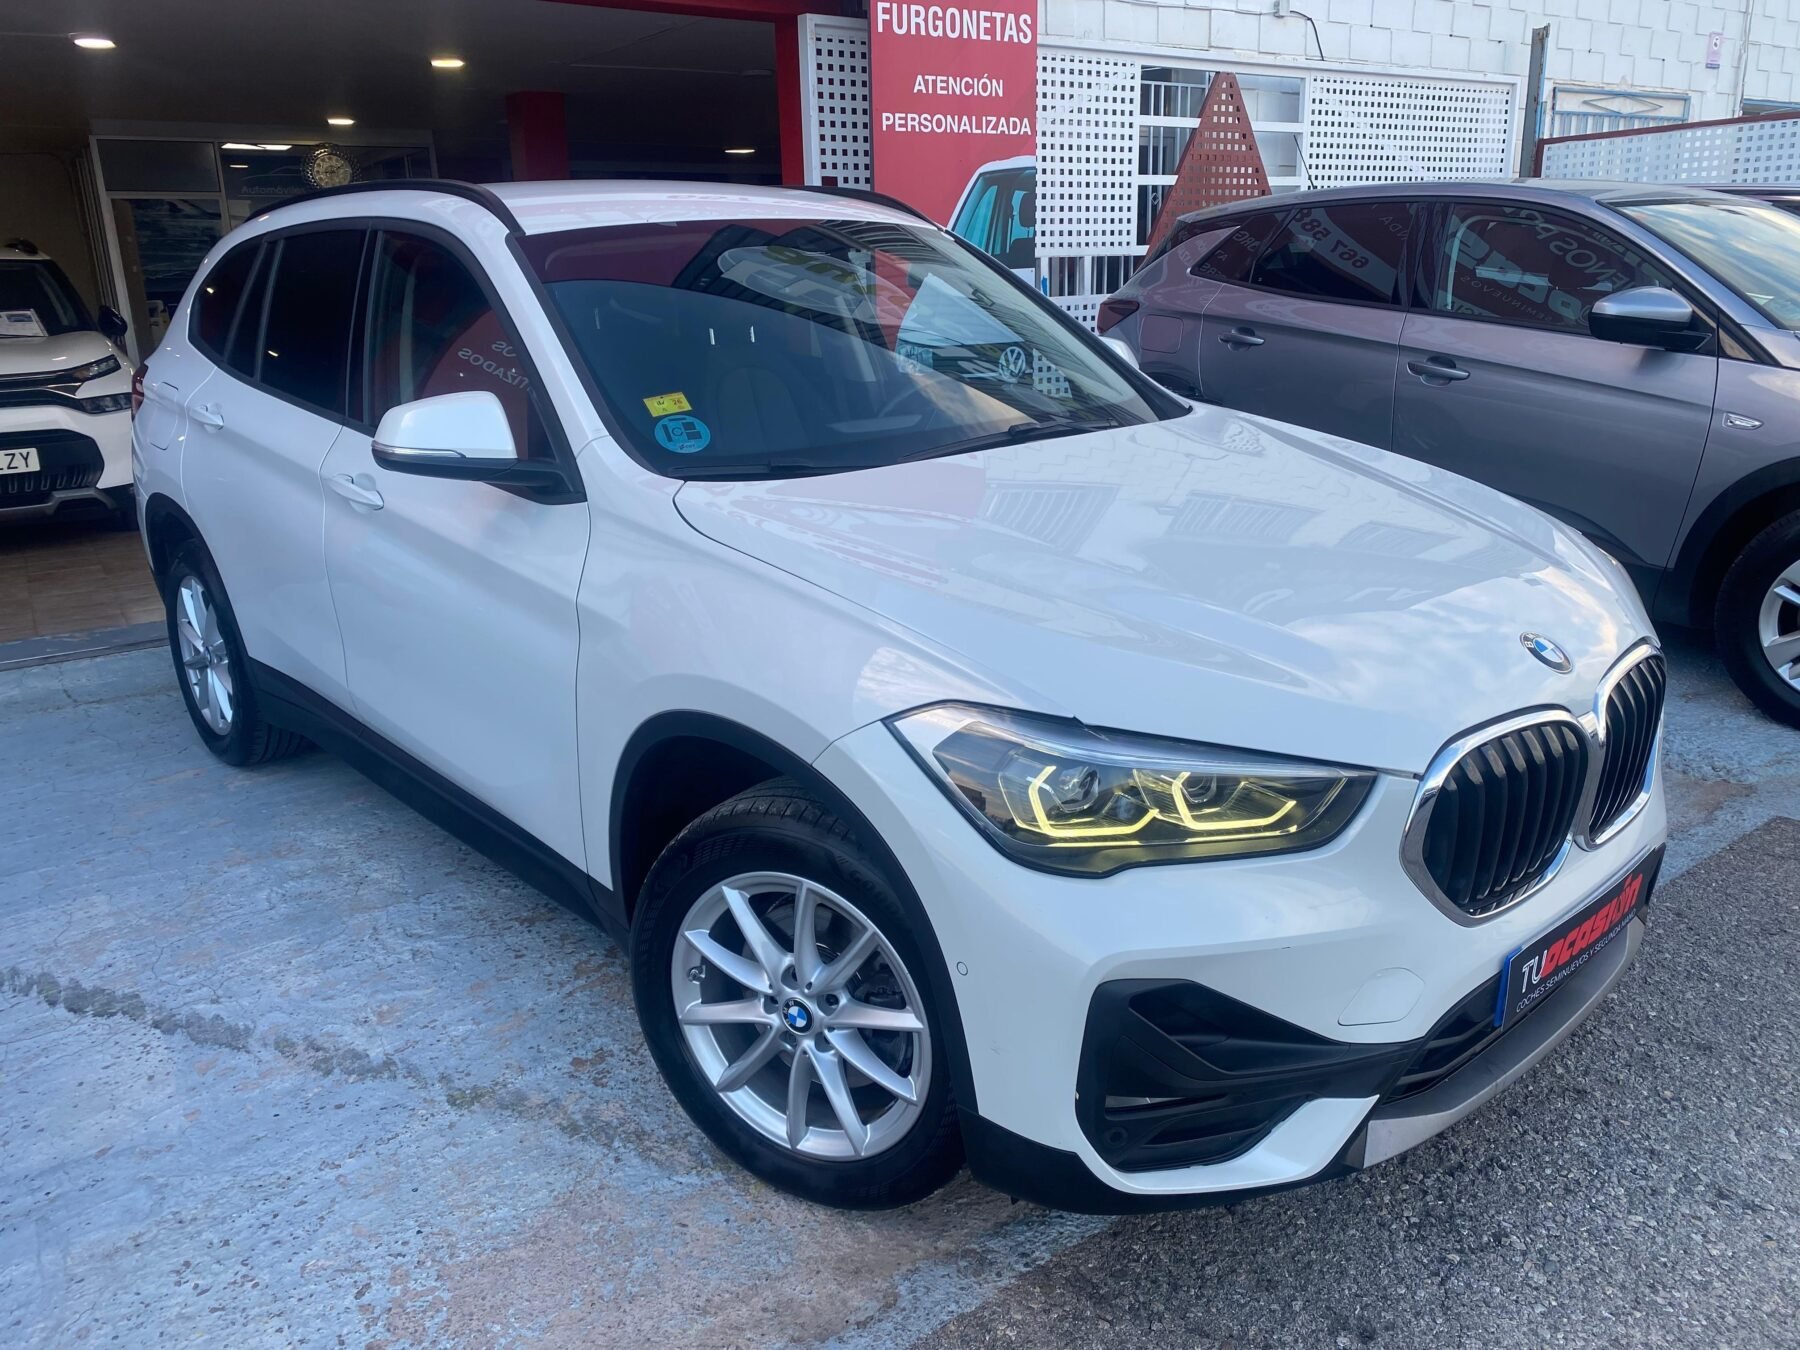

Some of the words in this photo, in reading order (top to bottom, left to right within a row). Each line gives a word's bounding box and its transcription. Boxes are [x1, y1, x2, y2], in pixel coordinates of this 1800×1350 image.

[877, 2, 1032, 44] FURGONETAS
[913, 74, 1003, 97] ATENCIÓN
[882, 113, 1031, 135] PERSONALIZADA
[0, 451, 30, 470] ZY
[1516, 984, 1546, 1013] COCHES
[1545, 951, 1590, 991] SEMINUEVOS
